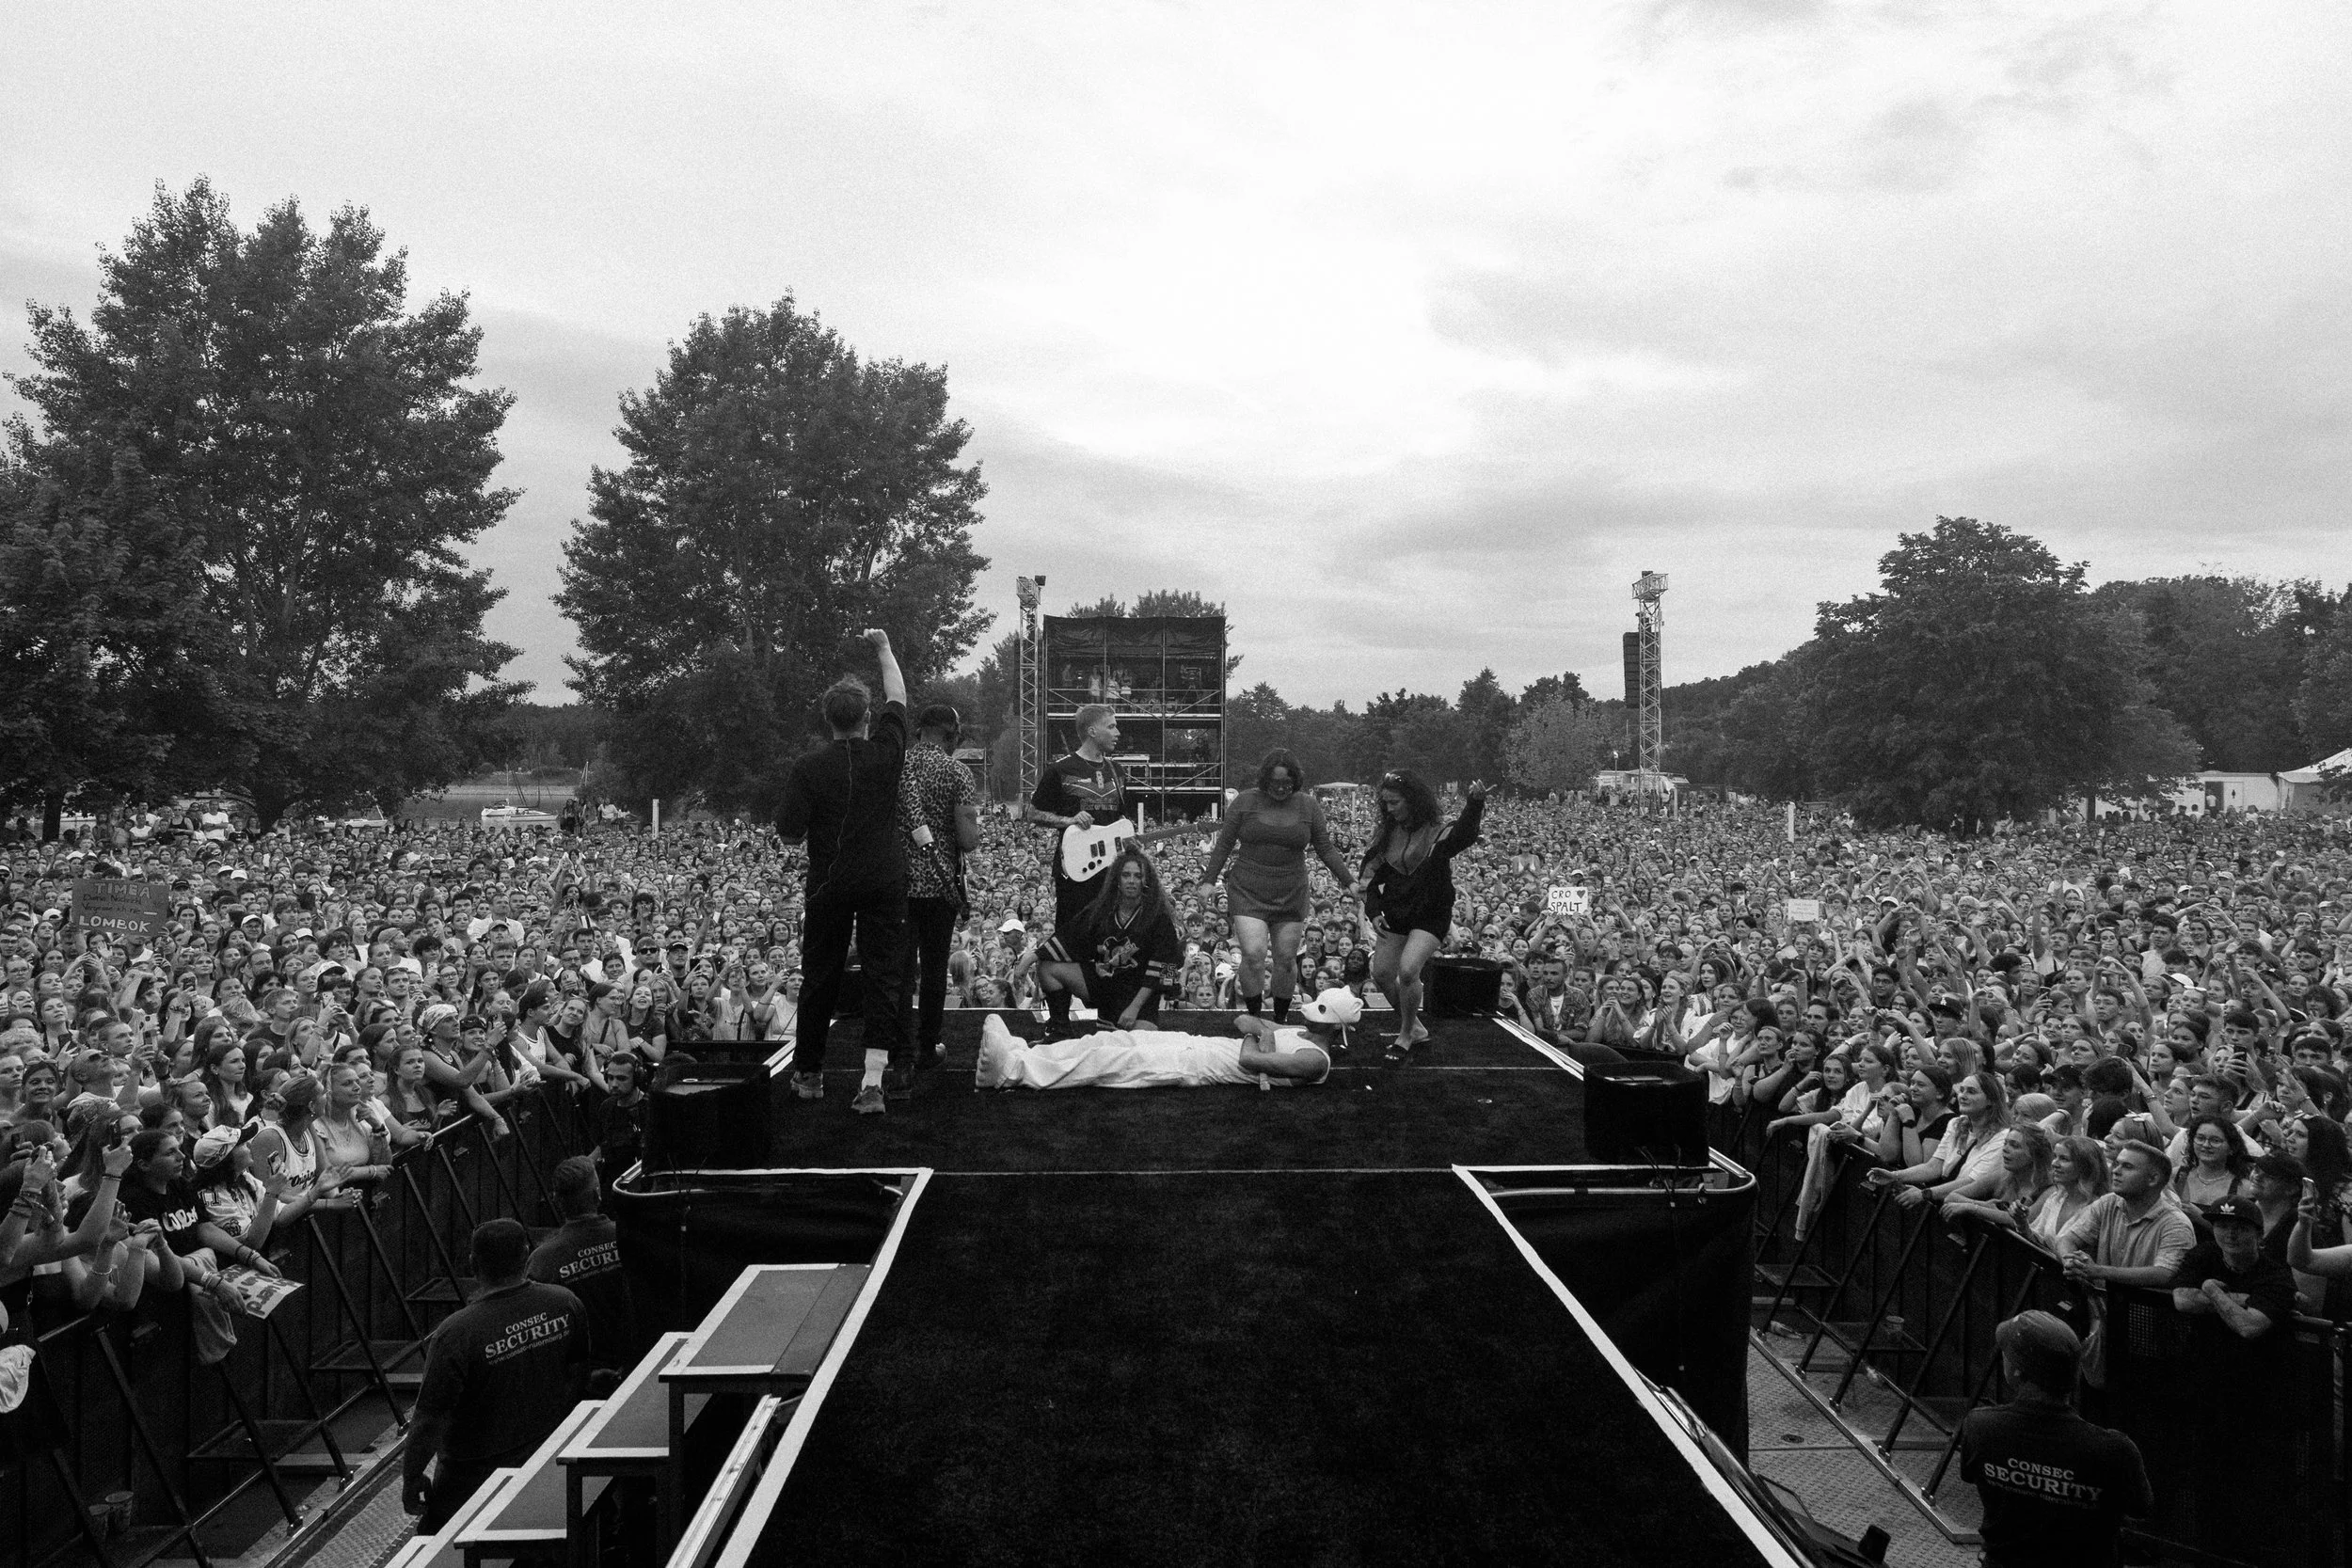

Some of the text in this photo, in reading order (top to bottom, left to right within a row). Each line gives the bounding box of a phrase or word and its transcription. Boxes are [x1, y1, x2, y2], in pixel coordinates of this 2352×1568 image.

[95, 883, 151, 898] TIMEA
[1551, 890, 1571, 899] CRO
[1550, 901, 1582, 912] SPALT
[78, 915, 151, 933] LOMBOK
[577, 1241, 618, 1258] CONSEC
[505, 1312, 548, 1335] CONSEC
[485, 1313, 569, 1359] SECURITY
[2008, 1457, 2074, 1481] CONSEC
[1983, 1463, 2104, 1501] SECURITY
